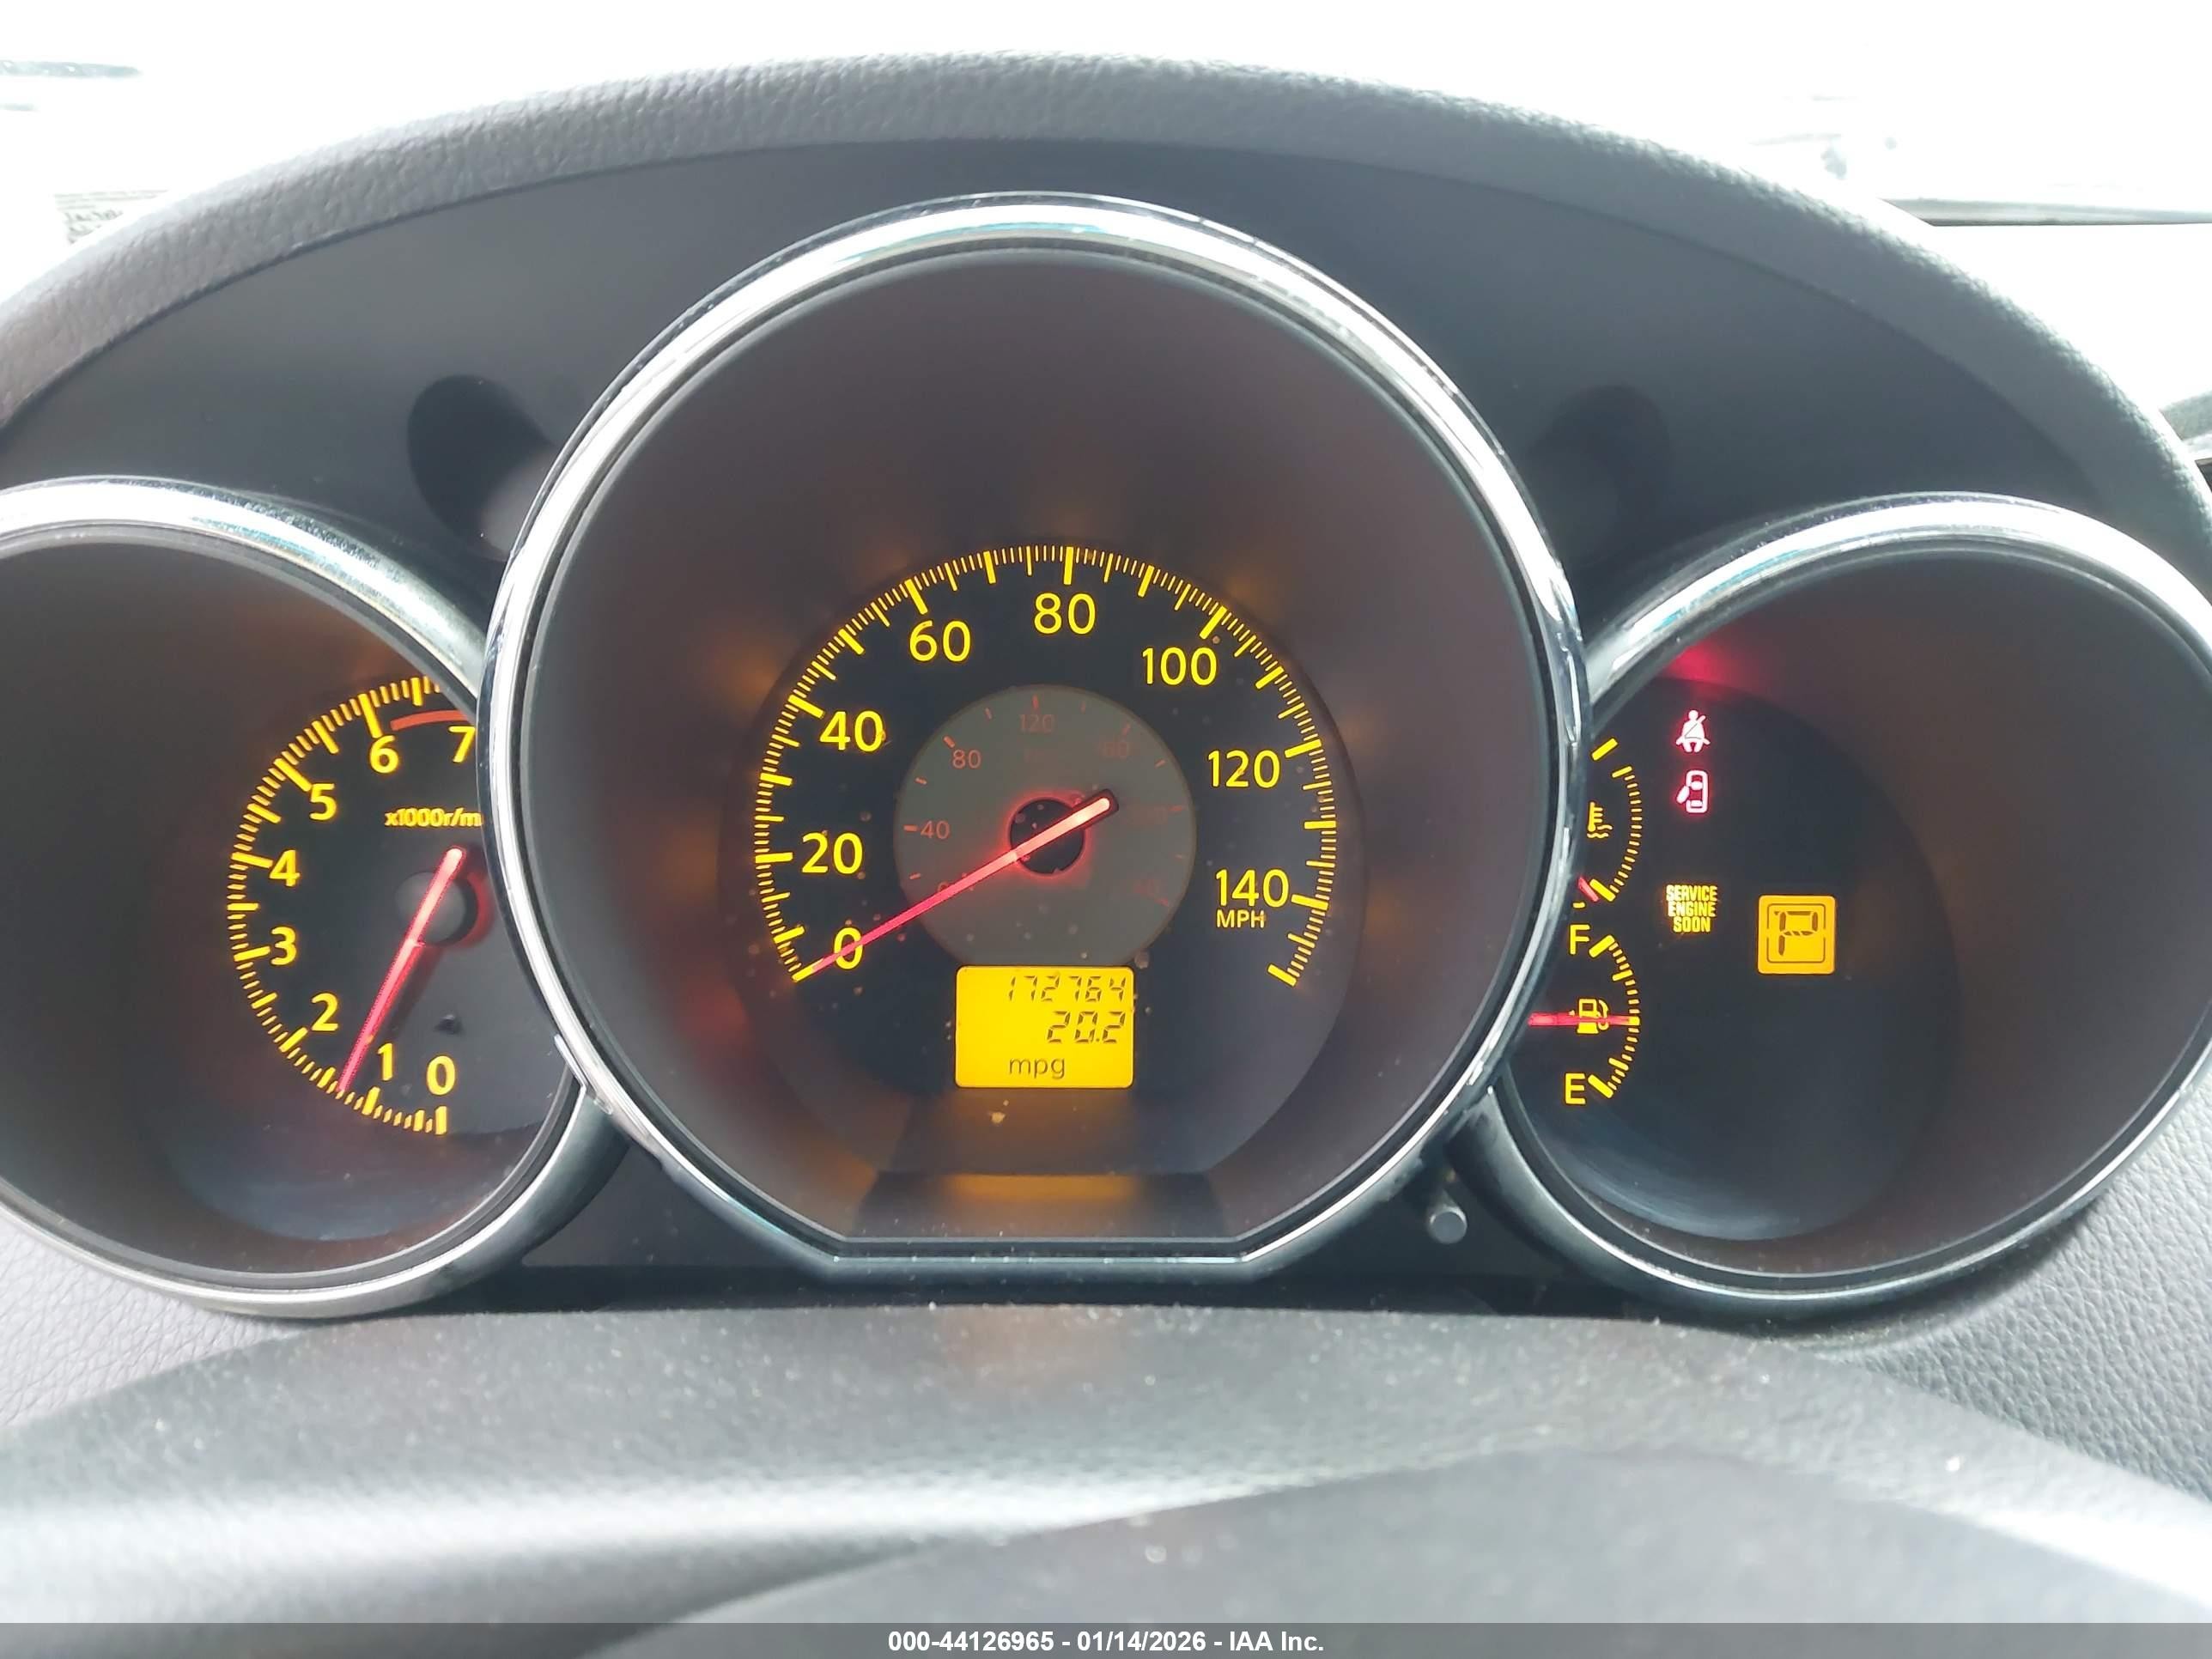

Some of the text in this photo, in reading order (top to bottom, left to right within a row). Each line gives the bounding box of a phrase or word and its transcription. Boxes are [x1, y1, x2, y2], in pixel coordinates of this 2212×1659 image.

[1034, 592, 1096, 635] 80
[909, 620, 971, 662] 60
[1142, 647, 1218, 686] 100
[448, 726, 477, 763] 7
[819, 710, 884, 751] 40
[369, 734, 399, 774] 6
[951, 749, 981, 769] 80
[1207, 750, 1280, 789] 120
[309, 782, 337, 821] 5
[921, 820, 951, 839] 40
[270, 849, 301, 887] 4
[801, 832, 863, 874] 20
[1215, 868, 1289, 908] 140
[1666, 884, 1717, 901] SERVICE
[1216, 910, 1266, 928] MPH
[1668, 901, 1717, 916] ENGINE
[1673, 916, 1711, 933] SOON
[270, 926, 297, 966] 3
[834, 927, 863, 969] 0
[1570, 924, 1590, 955] F
[1774, 911, 1818, 956] P
[1008, 975, 1127, 1001] 172764
[311, 993, 339, 1032] 2
[1047, 1011, 1126, 1043] 20.2
[377, 1042, 394, 1081] 1
[426, 1055, 457, 1096] 0
[1009, 1058, 1066, 1079] mpg
[1565, 1073, 1586, 1105] E
